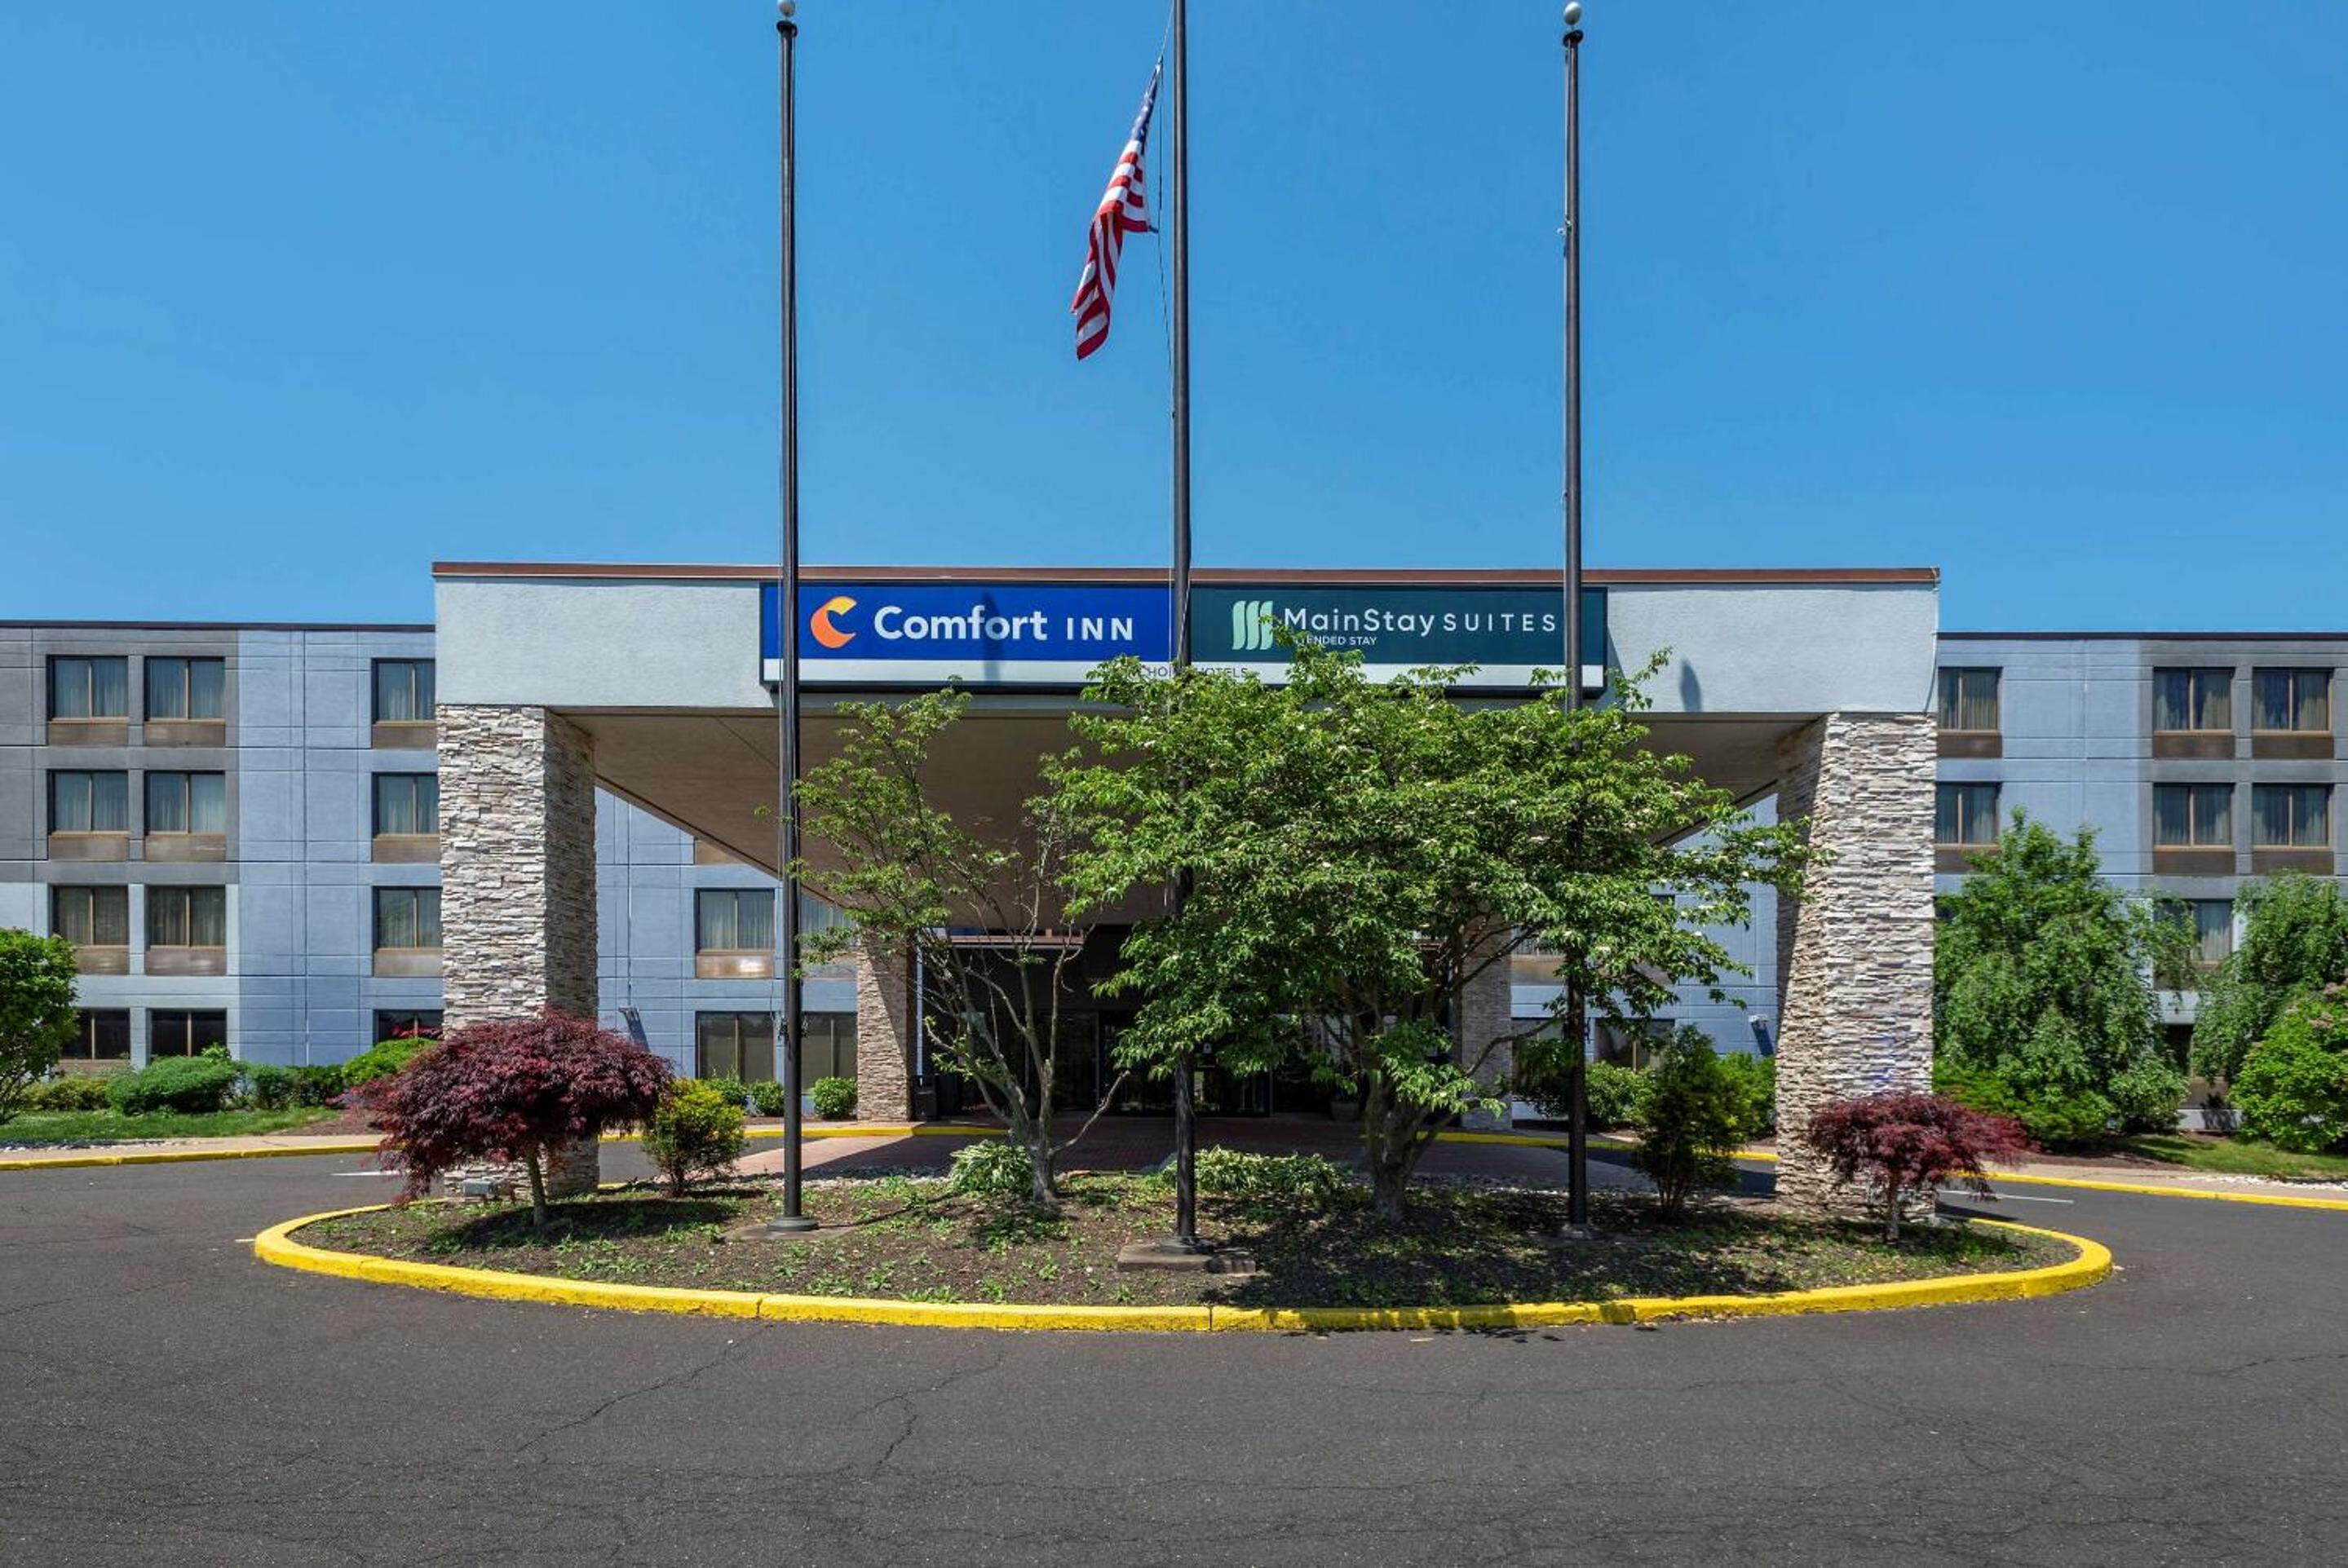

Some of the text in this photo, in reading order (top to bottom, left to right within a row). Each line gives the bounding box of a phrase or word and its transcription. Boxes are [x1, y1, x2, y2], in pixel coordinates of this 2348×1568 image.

[873, 605, 1133, 641] Comfort INN
[1284, 607, 1556, 638] MainStay SUITES
[1295, 634, 1377, 647] ENDED STAY
